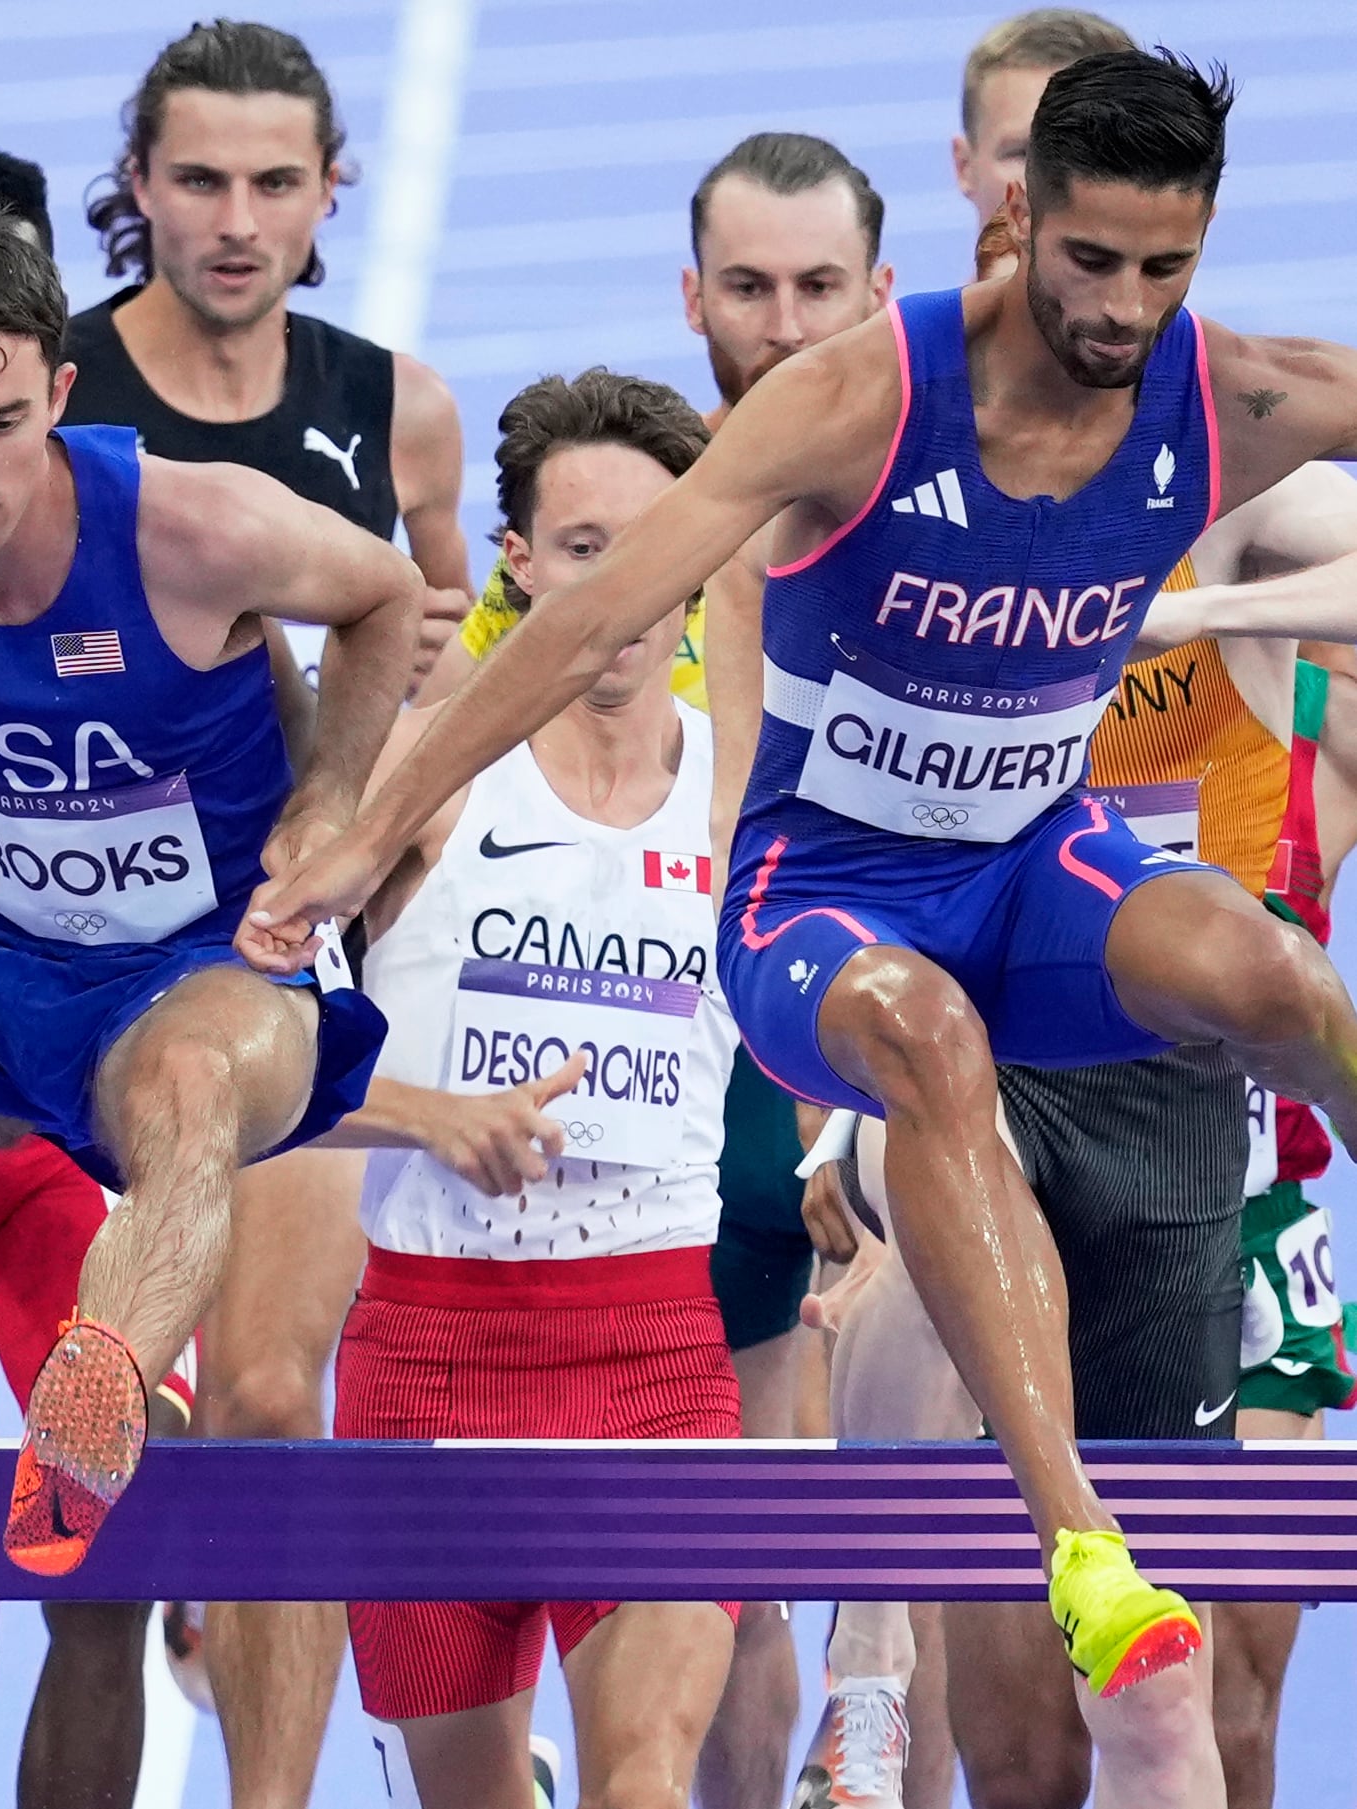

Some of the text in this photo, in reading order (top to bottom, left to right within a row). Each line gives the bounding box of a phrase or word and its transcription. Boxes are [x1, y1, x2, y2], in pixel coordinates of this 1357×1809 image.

[875, 572, 1146, 650] FRANCE
[906, 682, 1039, 710] PARIS 2024
[825, 712, 1082, 792] GILAVERT
[55, 798, 116, 813] 2024
[472, 908, 707, 985] CANADA
[527, 972, 654, 1004] PARIS 2024
